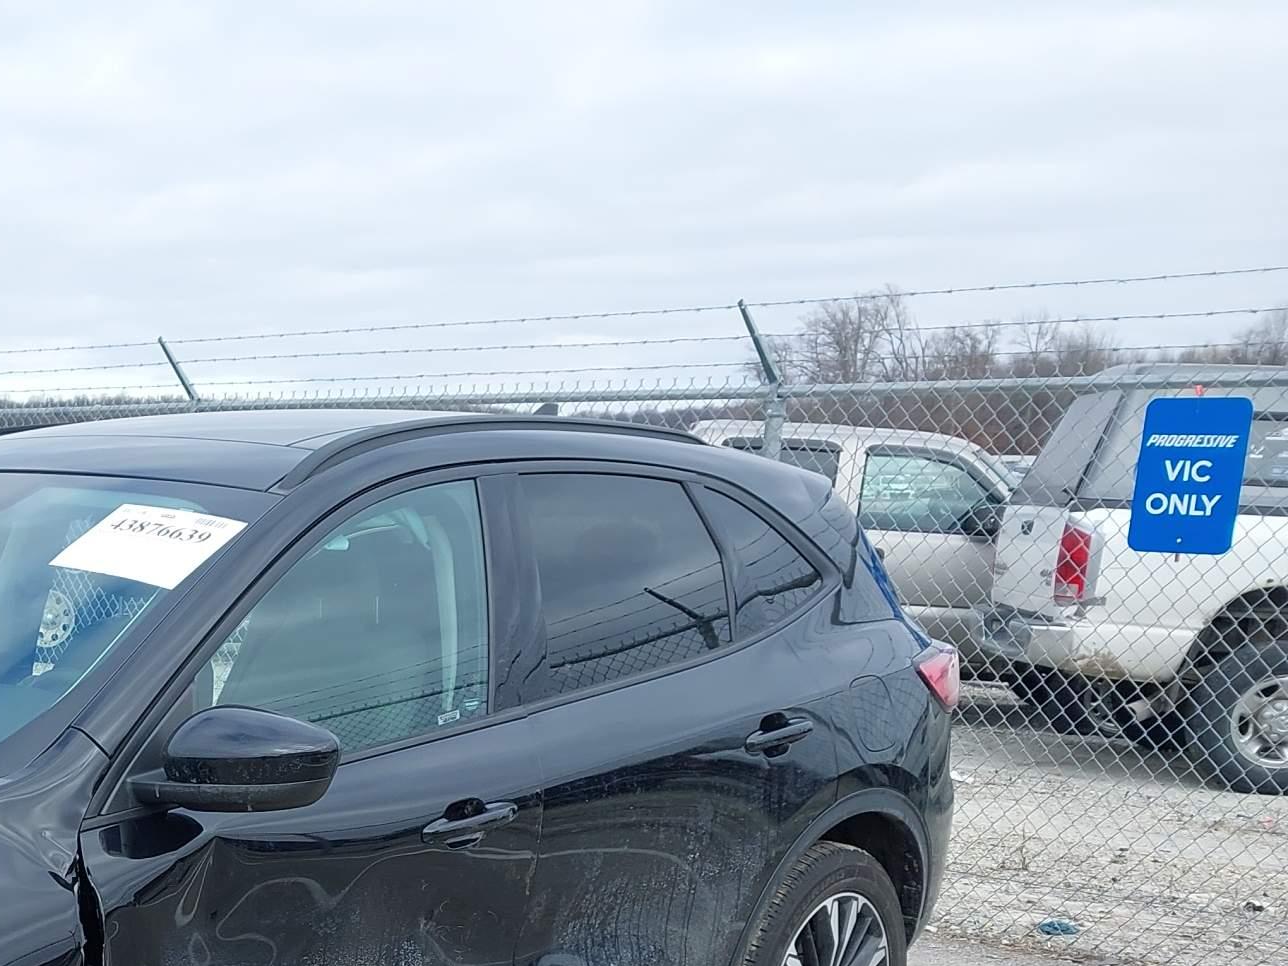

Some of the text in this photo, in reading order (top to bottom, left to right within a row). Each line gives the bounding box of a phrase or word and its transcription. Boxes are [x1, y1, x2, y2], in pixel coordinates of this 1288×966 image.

[1146, 434, 1240, 448] PROGRESSIVE
[1164, 459, 1213, 482] VIC
[1145, 492, 1222, 516] ONLY
[110, 518, 212, 543] 43876639
